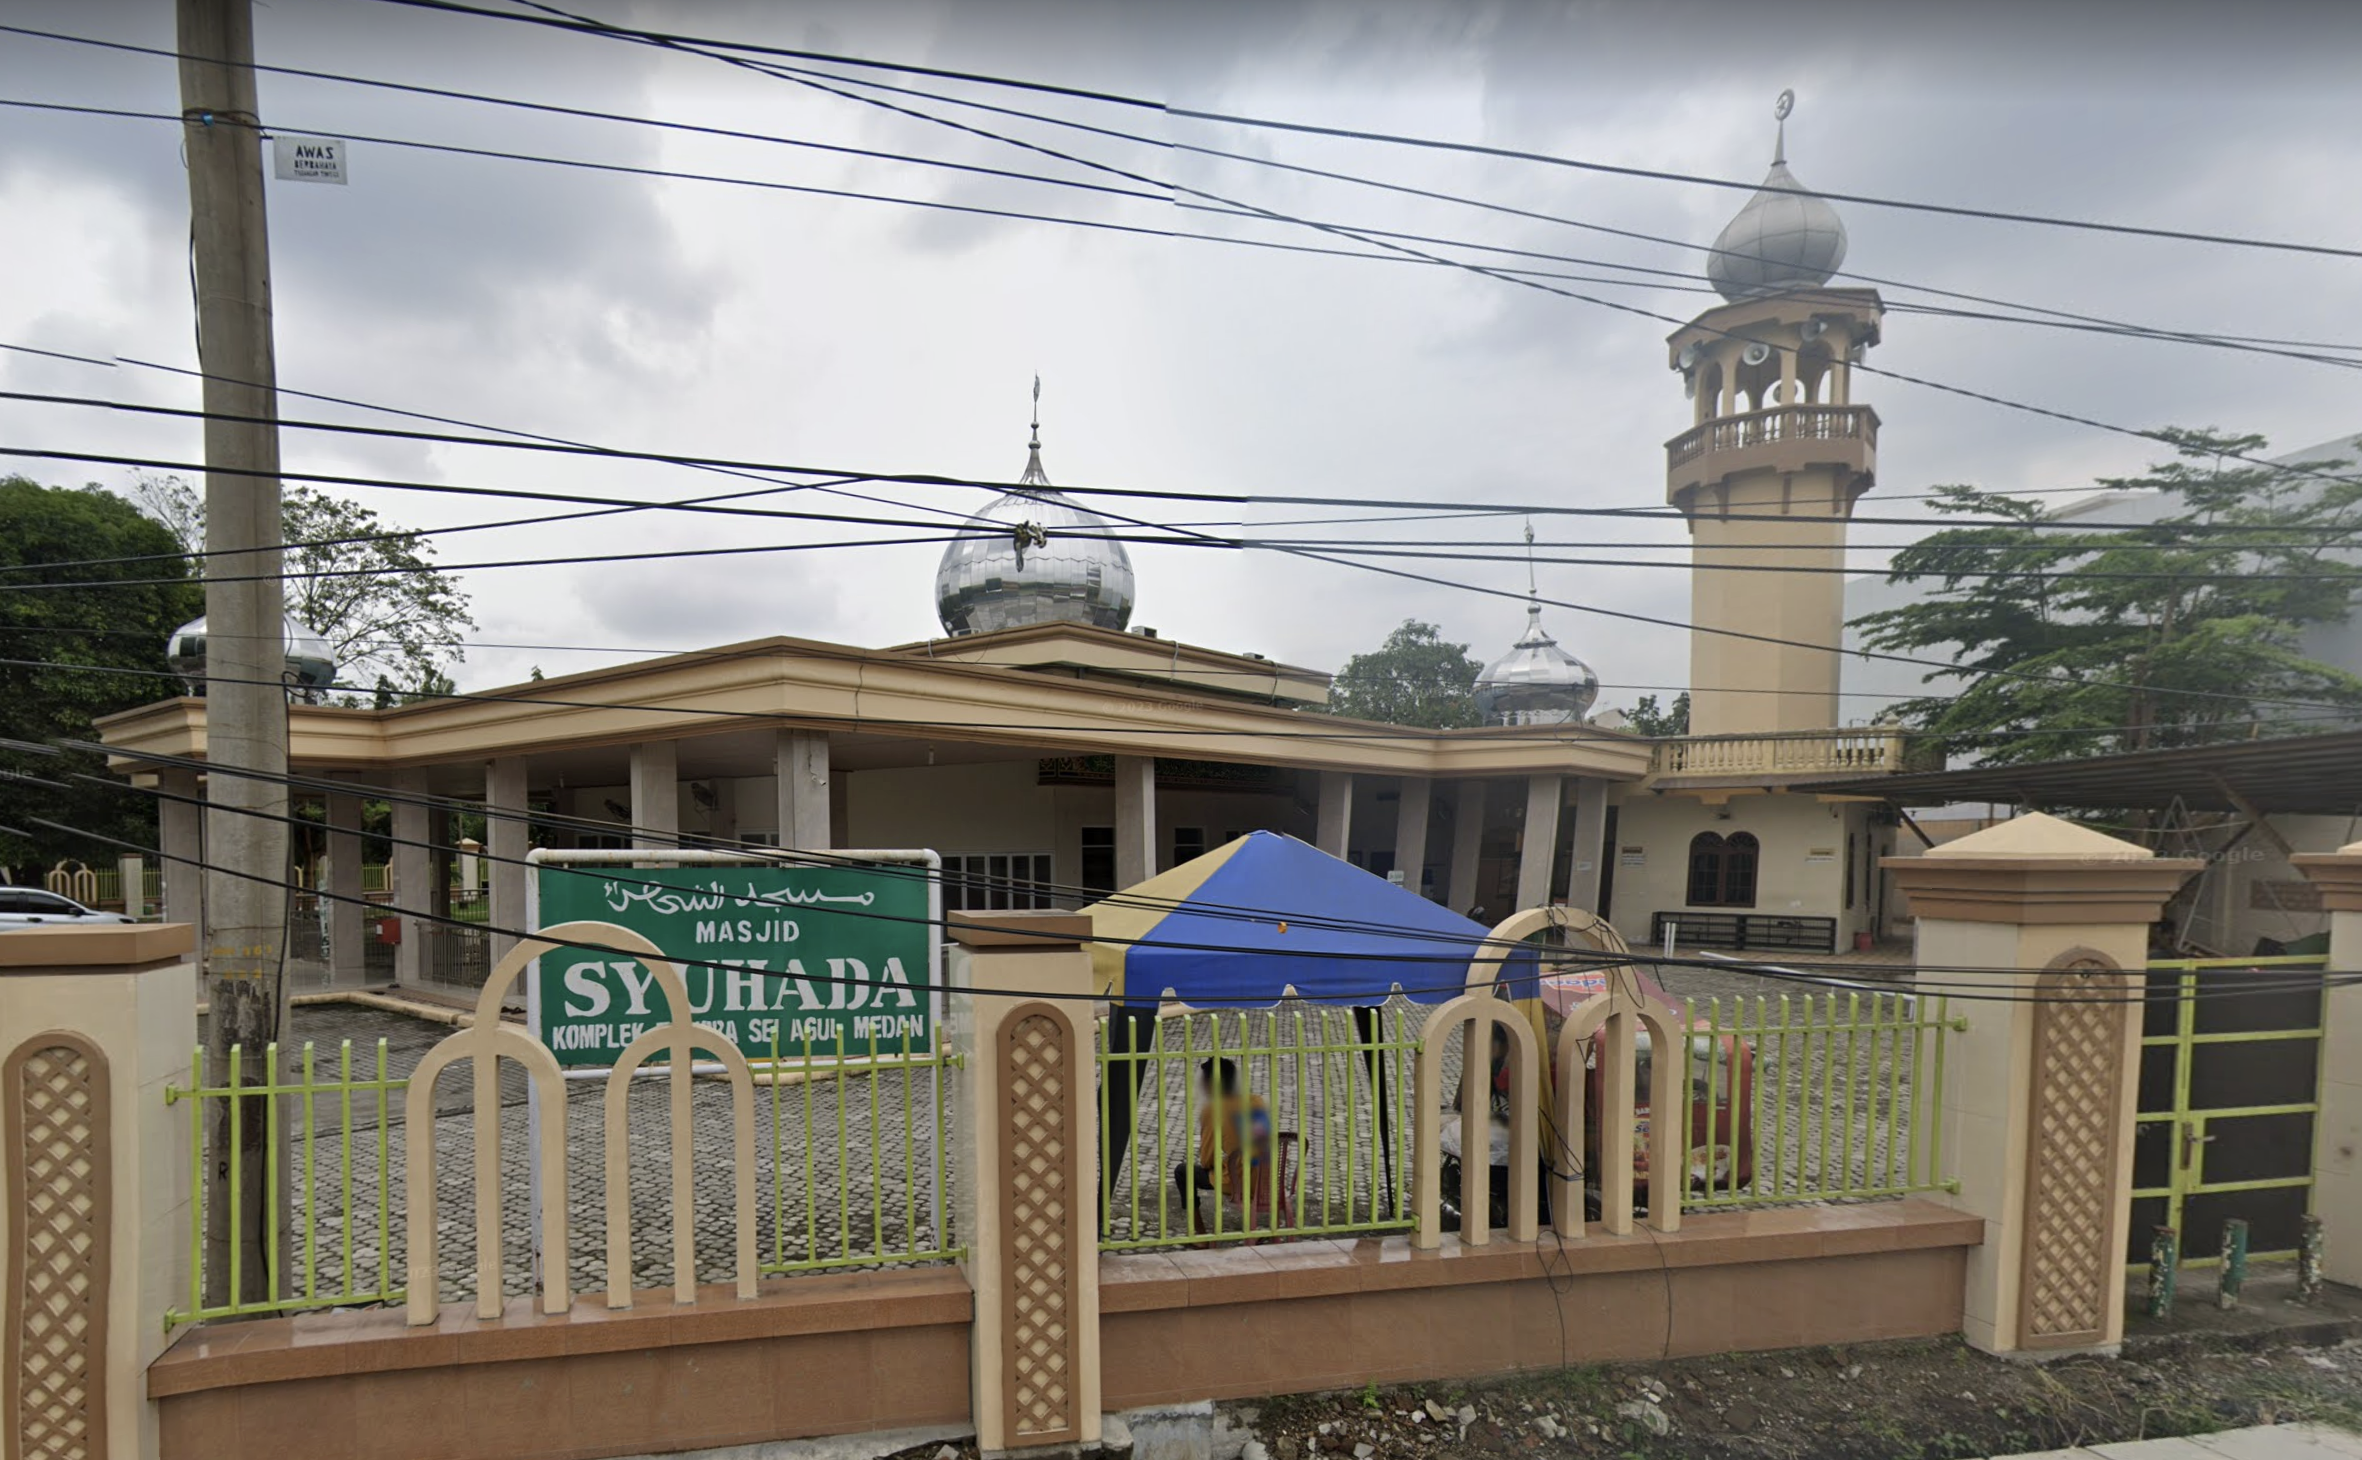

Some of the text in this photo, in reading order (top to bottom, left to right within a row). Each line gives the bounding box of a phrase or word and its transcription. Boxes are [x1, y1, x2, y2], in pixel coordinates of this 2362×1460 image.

[296, 145, 334, 160] AWAS
[695, 919, 800, 944] MASJID
[563, 957, 917, 1018] SYUHADA
[552, 1022, 645, 1051] KOMPLEK
[853, 1014, 924, 1040] MEDAN
[218, 1161, 229, 1181] R
